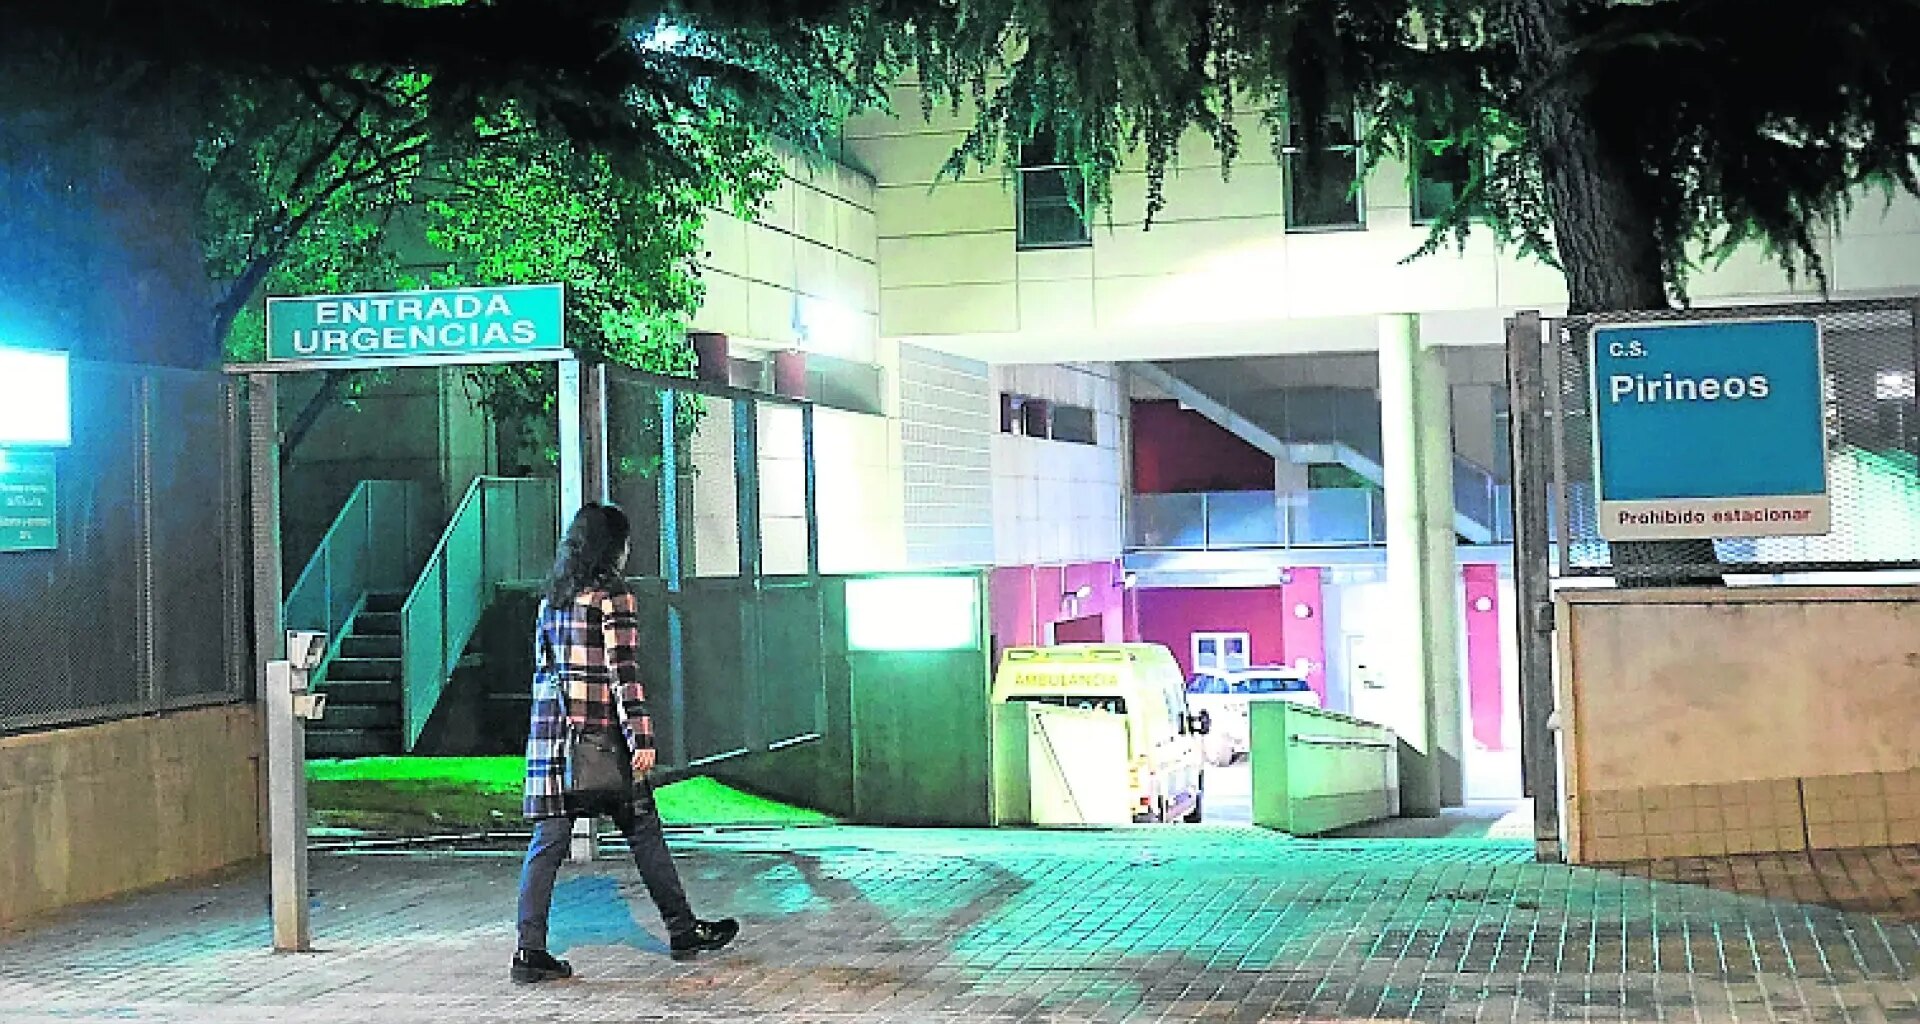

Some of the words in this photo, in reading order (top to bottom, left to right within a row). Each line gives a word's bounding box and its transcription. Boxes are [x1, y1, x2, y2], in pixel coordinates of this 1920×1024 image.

[316, 295, 511, 325] ENTRADA
[293, 320, 537, 352] URGENCIAS
[1609, 340, 1648, 357] C.S.
[1611, 373, 1769, 402] Pirineos
[1618, 509, 1705, 525] Prohibido
[1711, 508, 1812, 523] estacionar
[1015, 672, 1118, 687] AMBULANCIA
